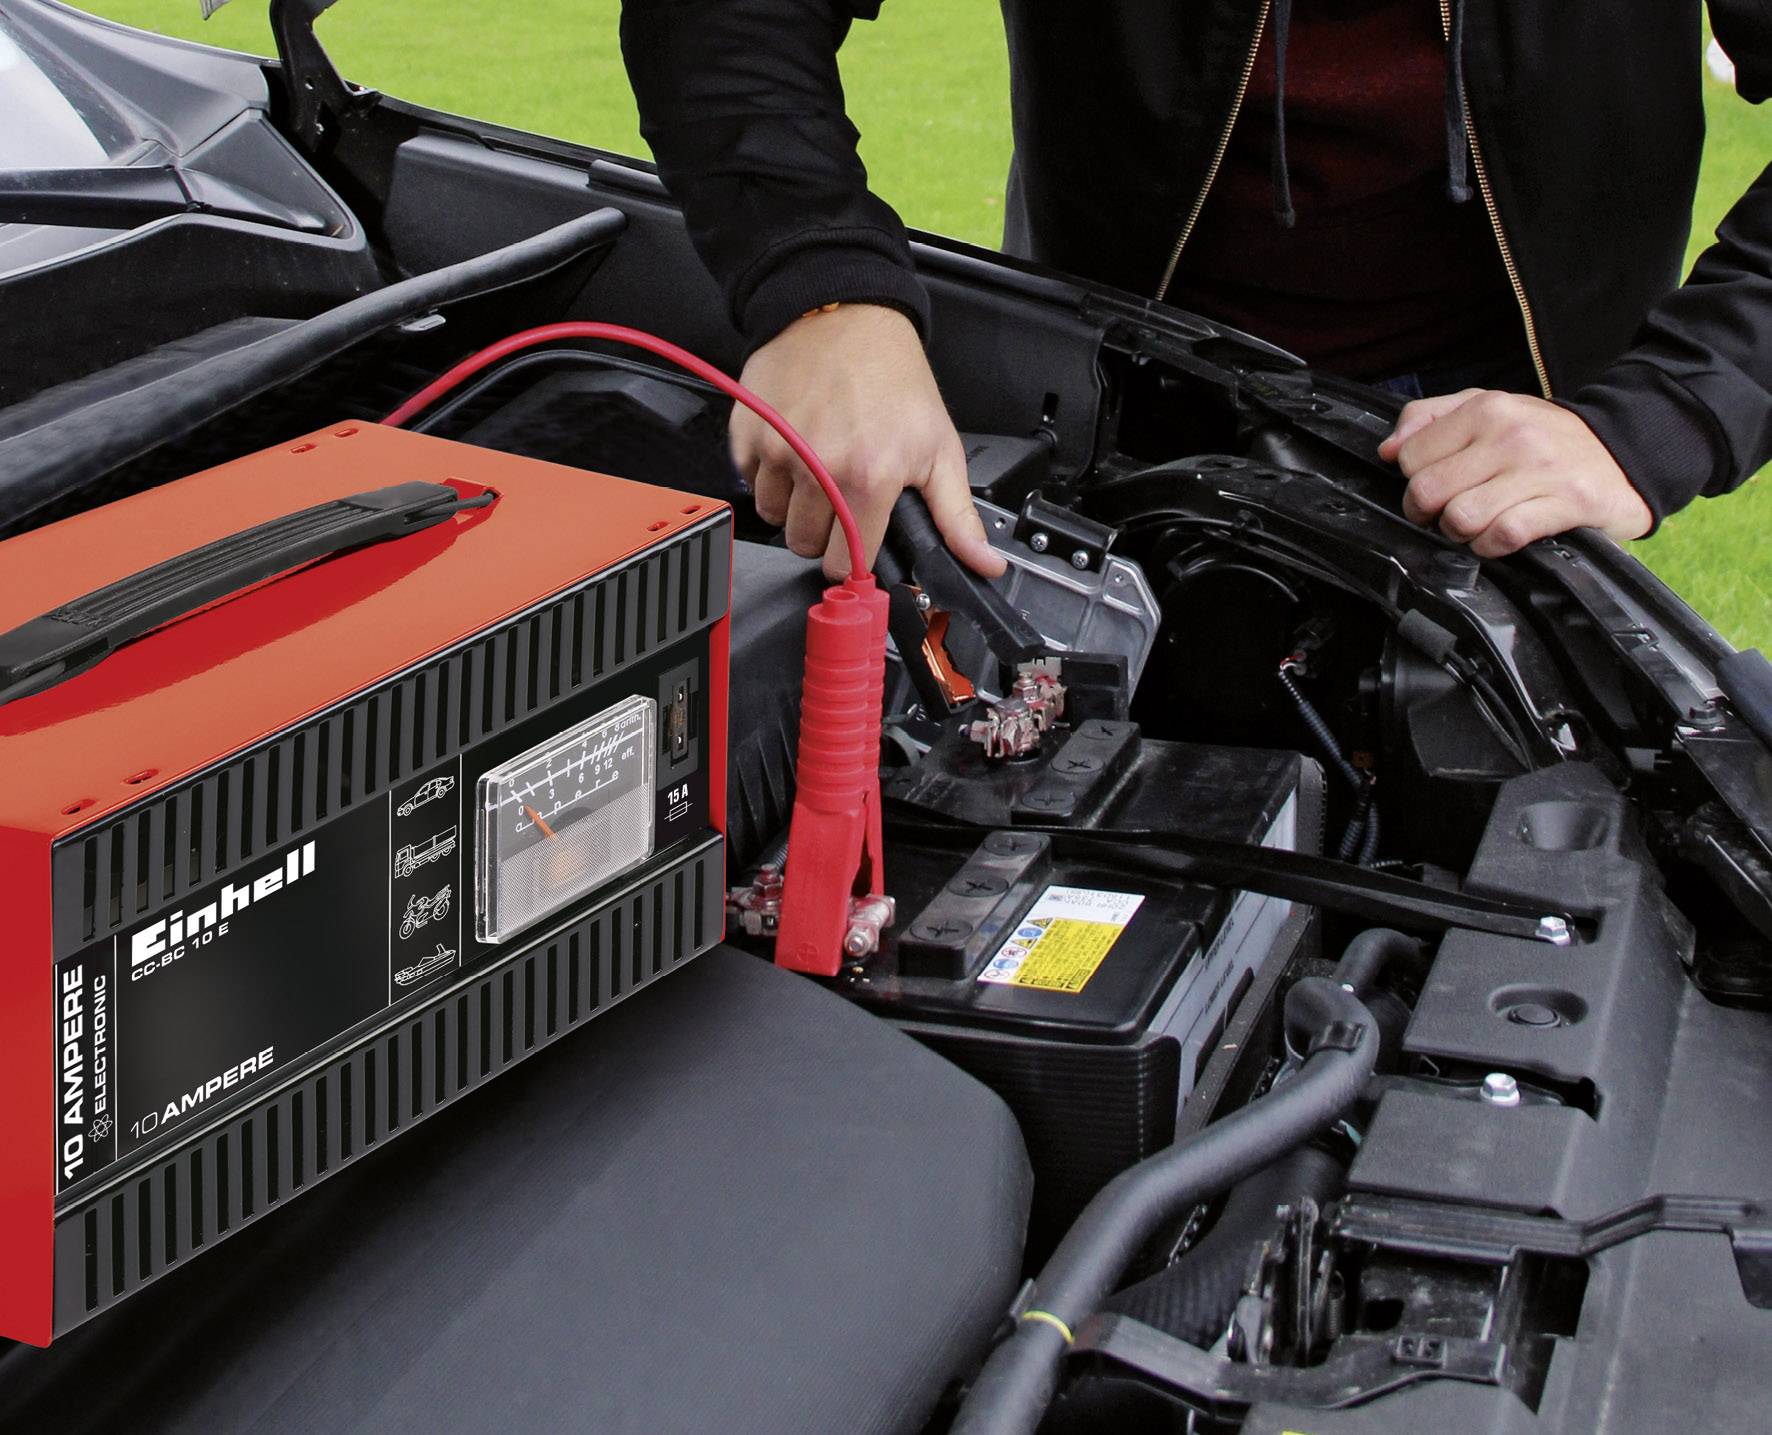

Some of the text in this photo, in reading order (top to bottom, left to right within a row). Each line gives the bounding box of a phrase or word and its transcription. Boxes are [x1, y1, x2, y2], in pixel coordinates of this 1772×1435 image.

[518, 805, 524, 816] 0
[548, 788, 555, 800] 3
[578, 771, 584, 783] 6
[594, 764, 601, 775] 9
[603, 757, 613, 770] 12
[667, 783, 689, 805] 15 A
[131, 840, 315, 967] Einhell
[131, 922, 229, 981] CC-BC 10 E
[63, 964, 84, 1179] 10 AMPERE
[94, 974, 107, 1115] ELECTRONIC
